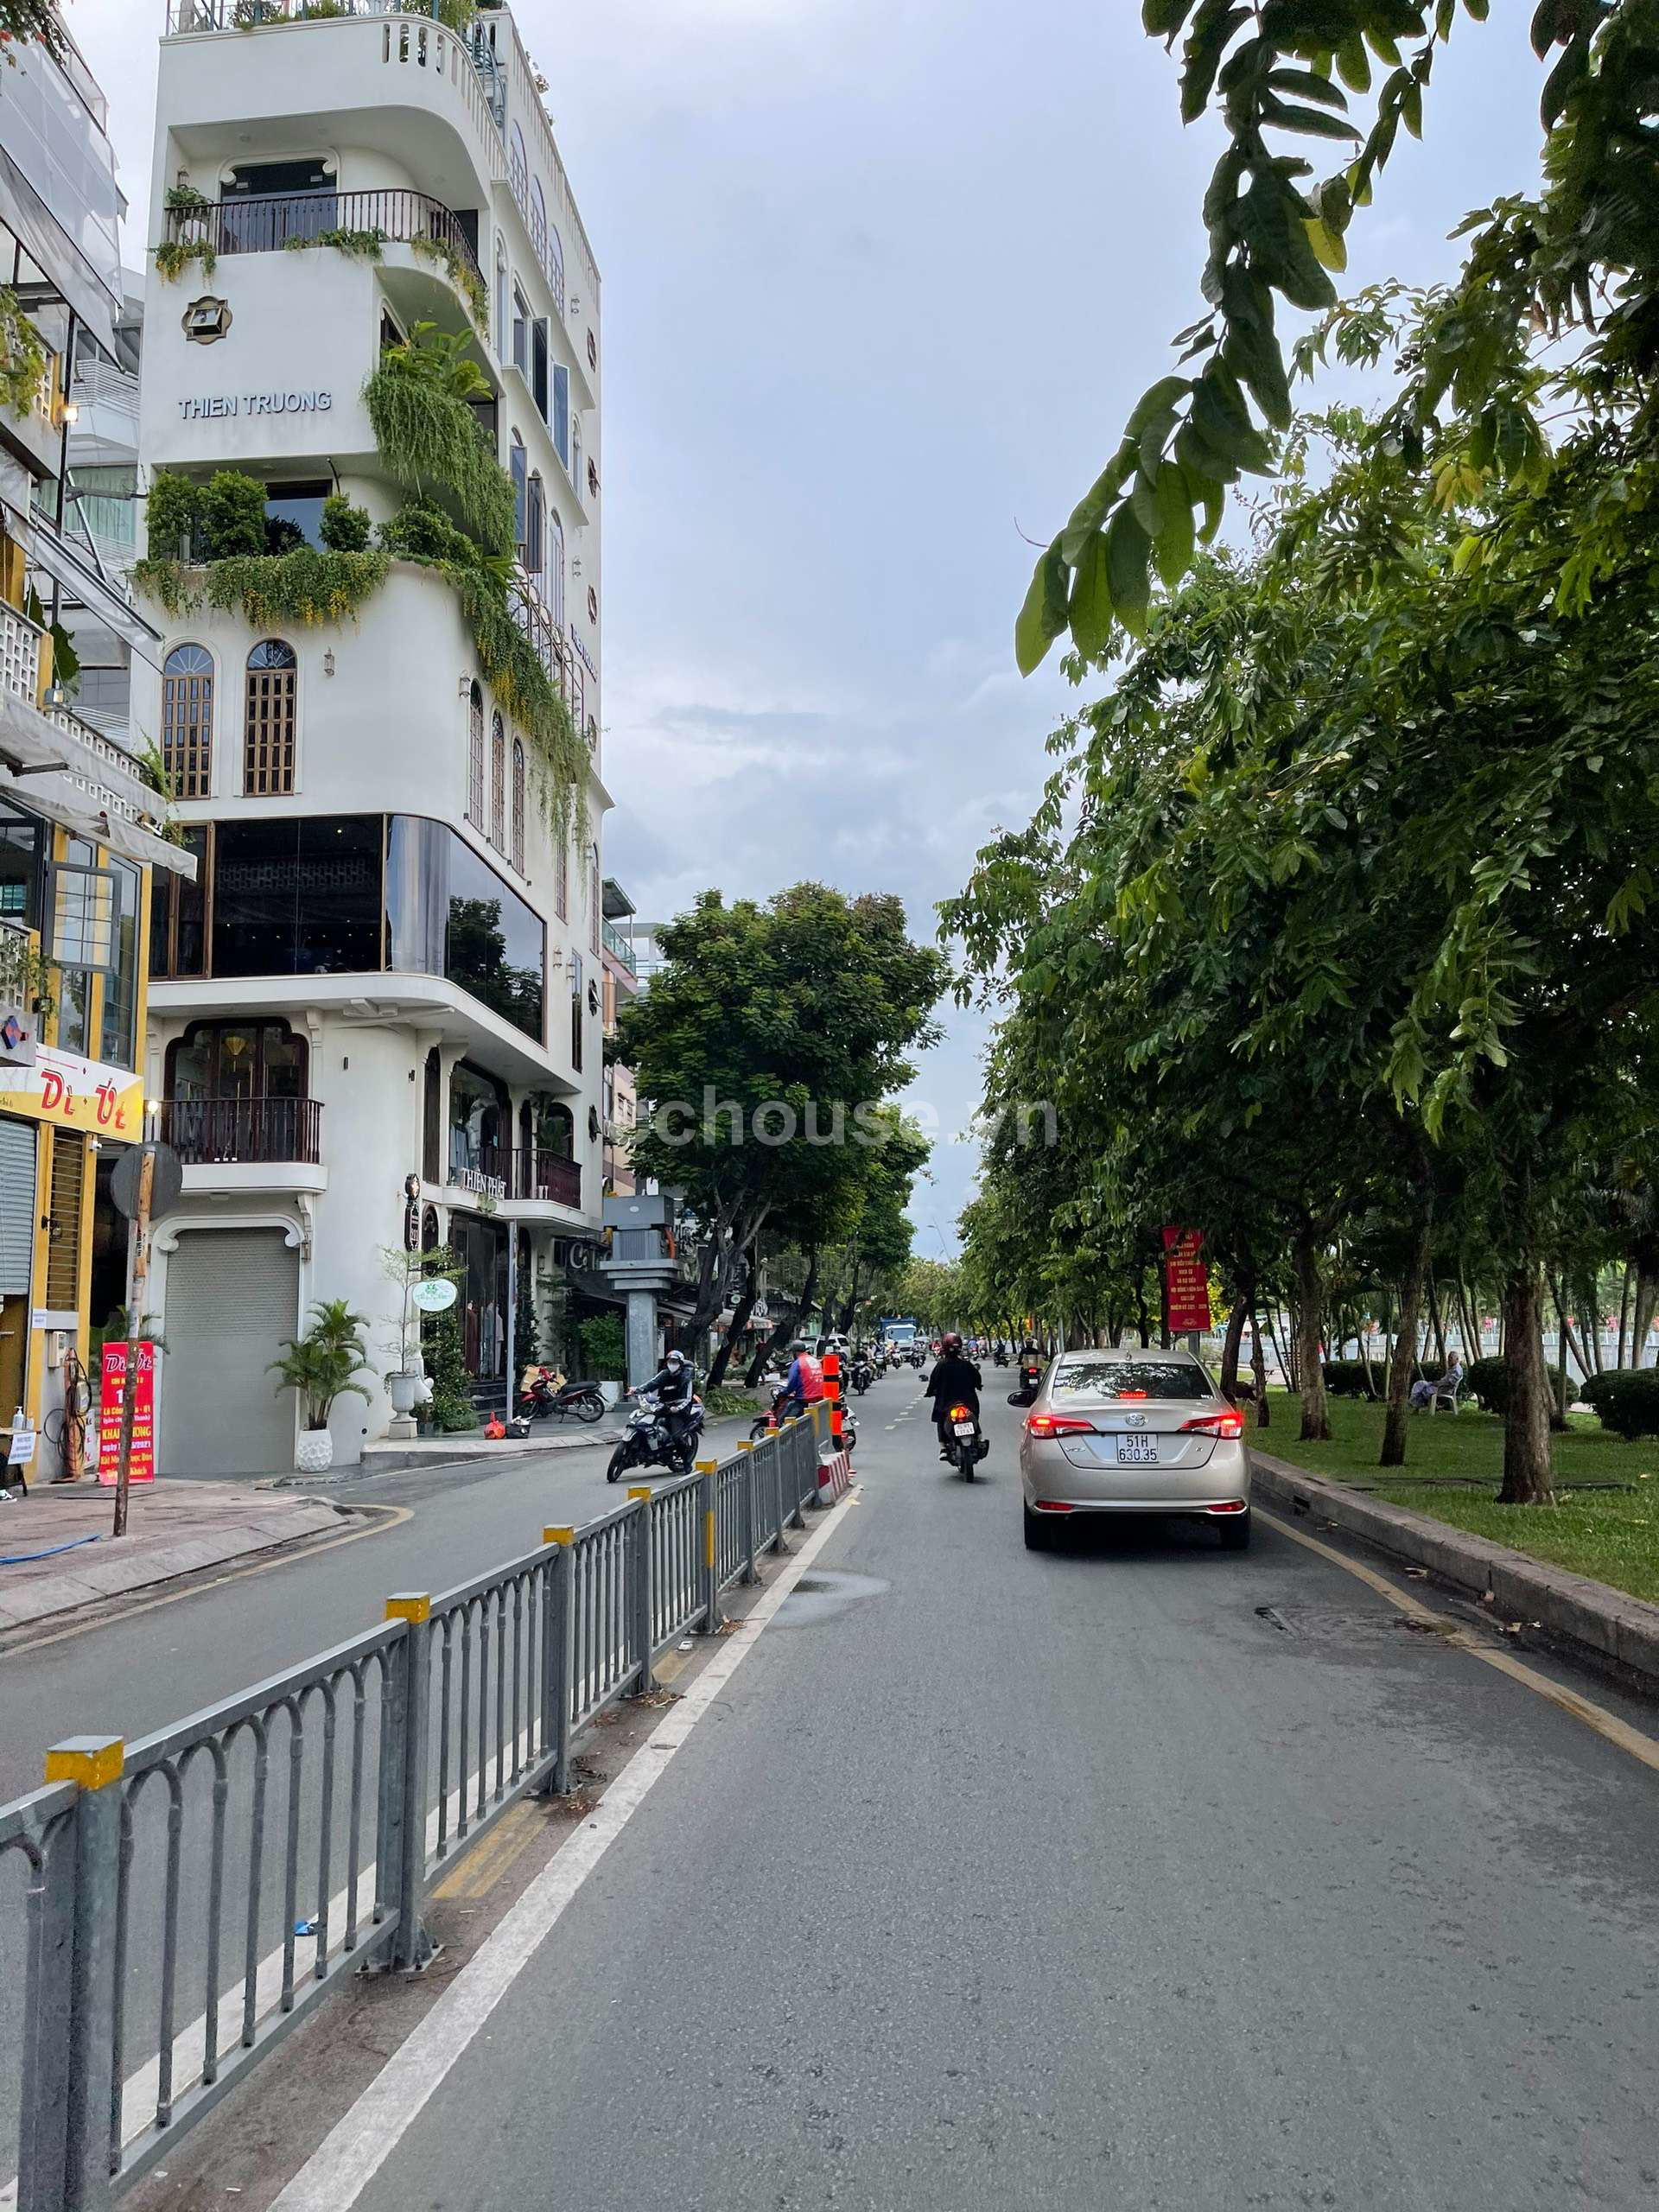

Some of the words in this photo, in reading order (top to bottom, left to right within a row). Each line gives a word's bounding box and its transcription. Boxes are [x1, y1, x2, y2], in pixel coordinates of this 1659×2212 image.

[179, 395, 238, 420] THIEN
[244, 391, 332, 415] TRUONG
[41, 1068, 75, 1116] Dì
[95, 1077, 125, 1129] Út
[1126, 1435, 1148, 1447] 51H
[1119, 1449, 1157, 1461] 630.35
